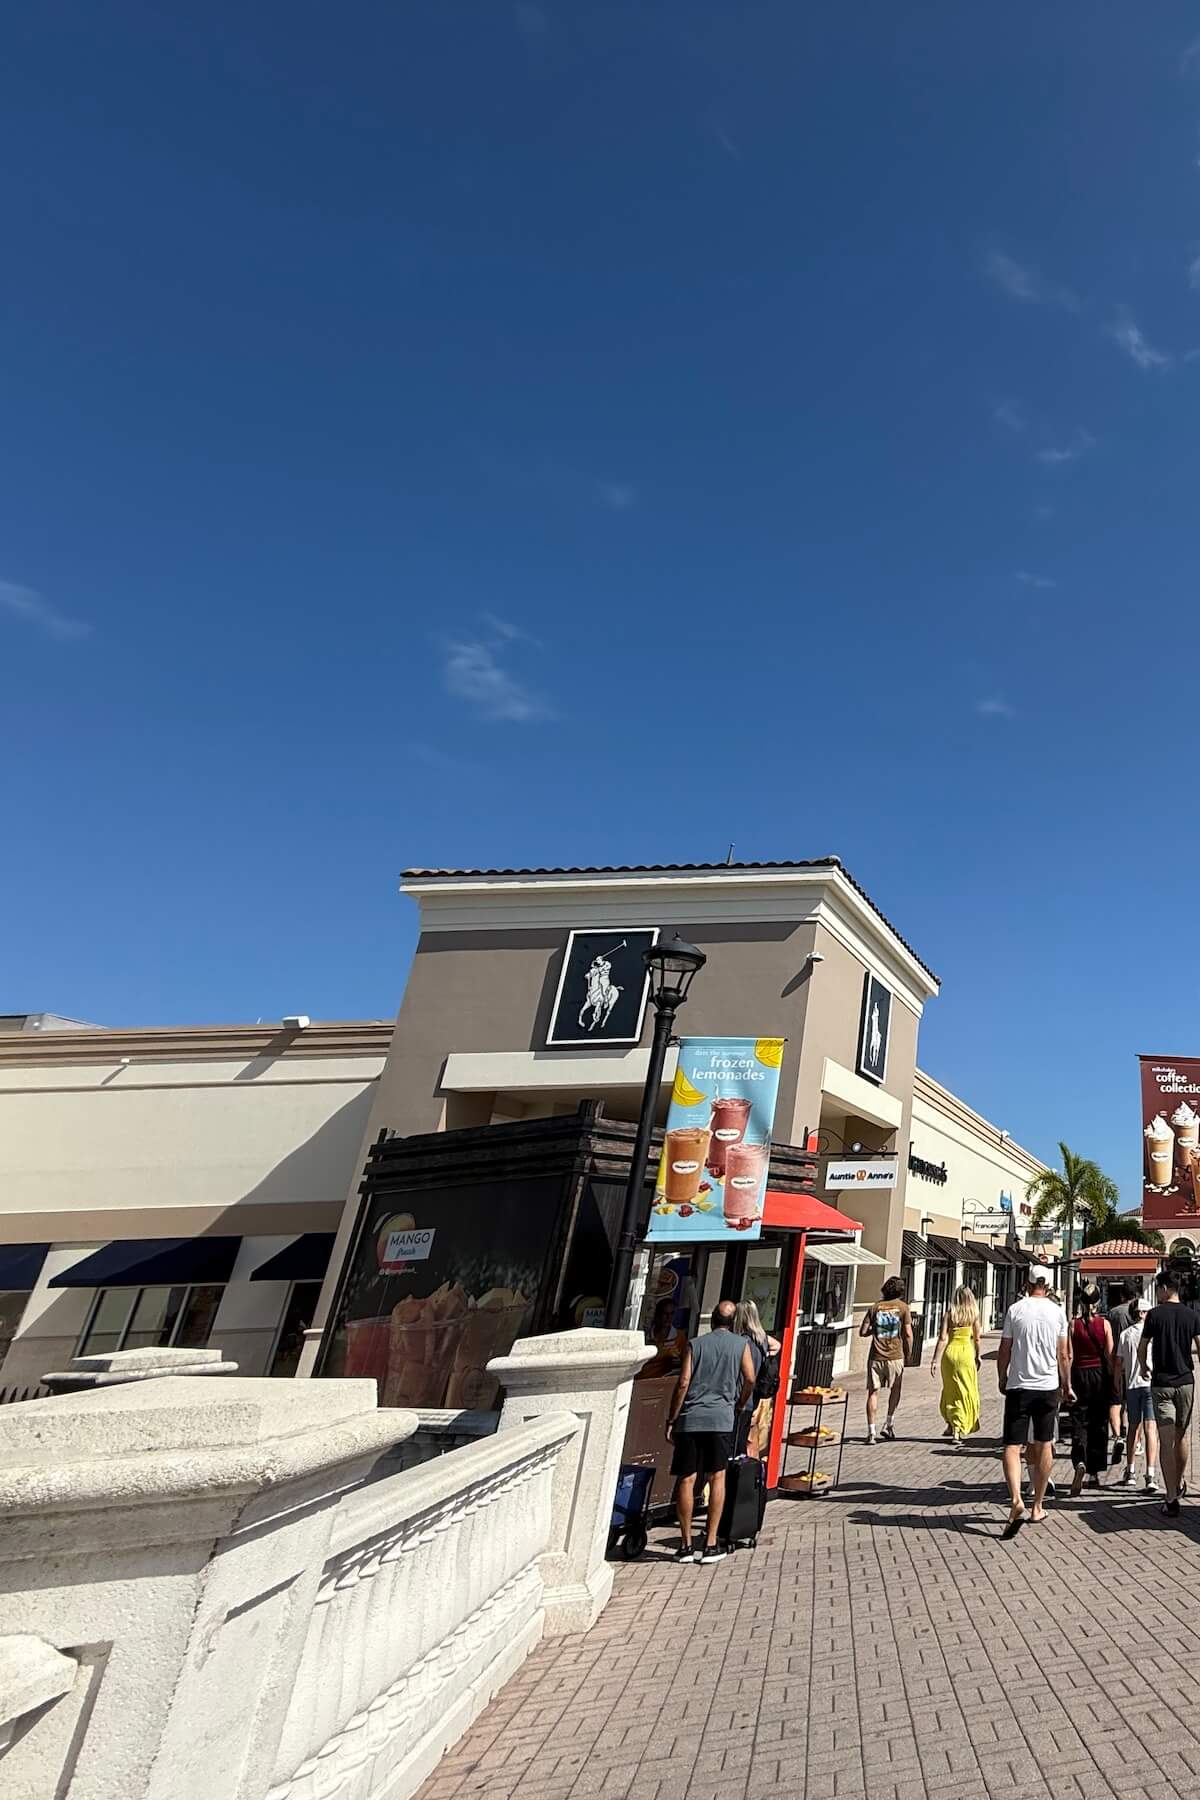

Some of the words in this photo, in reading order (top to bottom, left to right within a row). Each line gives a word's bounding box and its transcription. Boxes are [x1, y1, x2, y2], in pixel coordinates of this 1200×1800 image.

[710, 1055, 755, 1069] frozen
[692, 1067, 766, 1081] lemonades
[1155, 1072, 1188, 1083] coffee
[828, 1172, 856, 1181] Auntie
[867, 1171, 894, 1180] Anne's
[390, 1232, 431, 1246] MANGO
